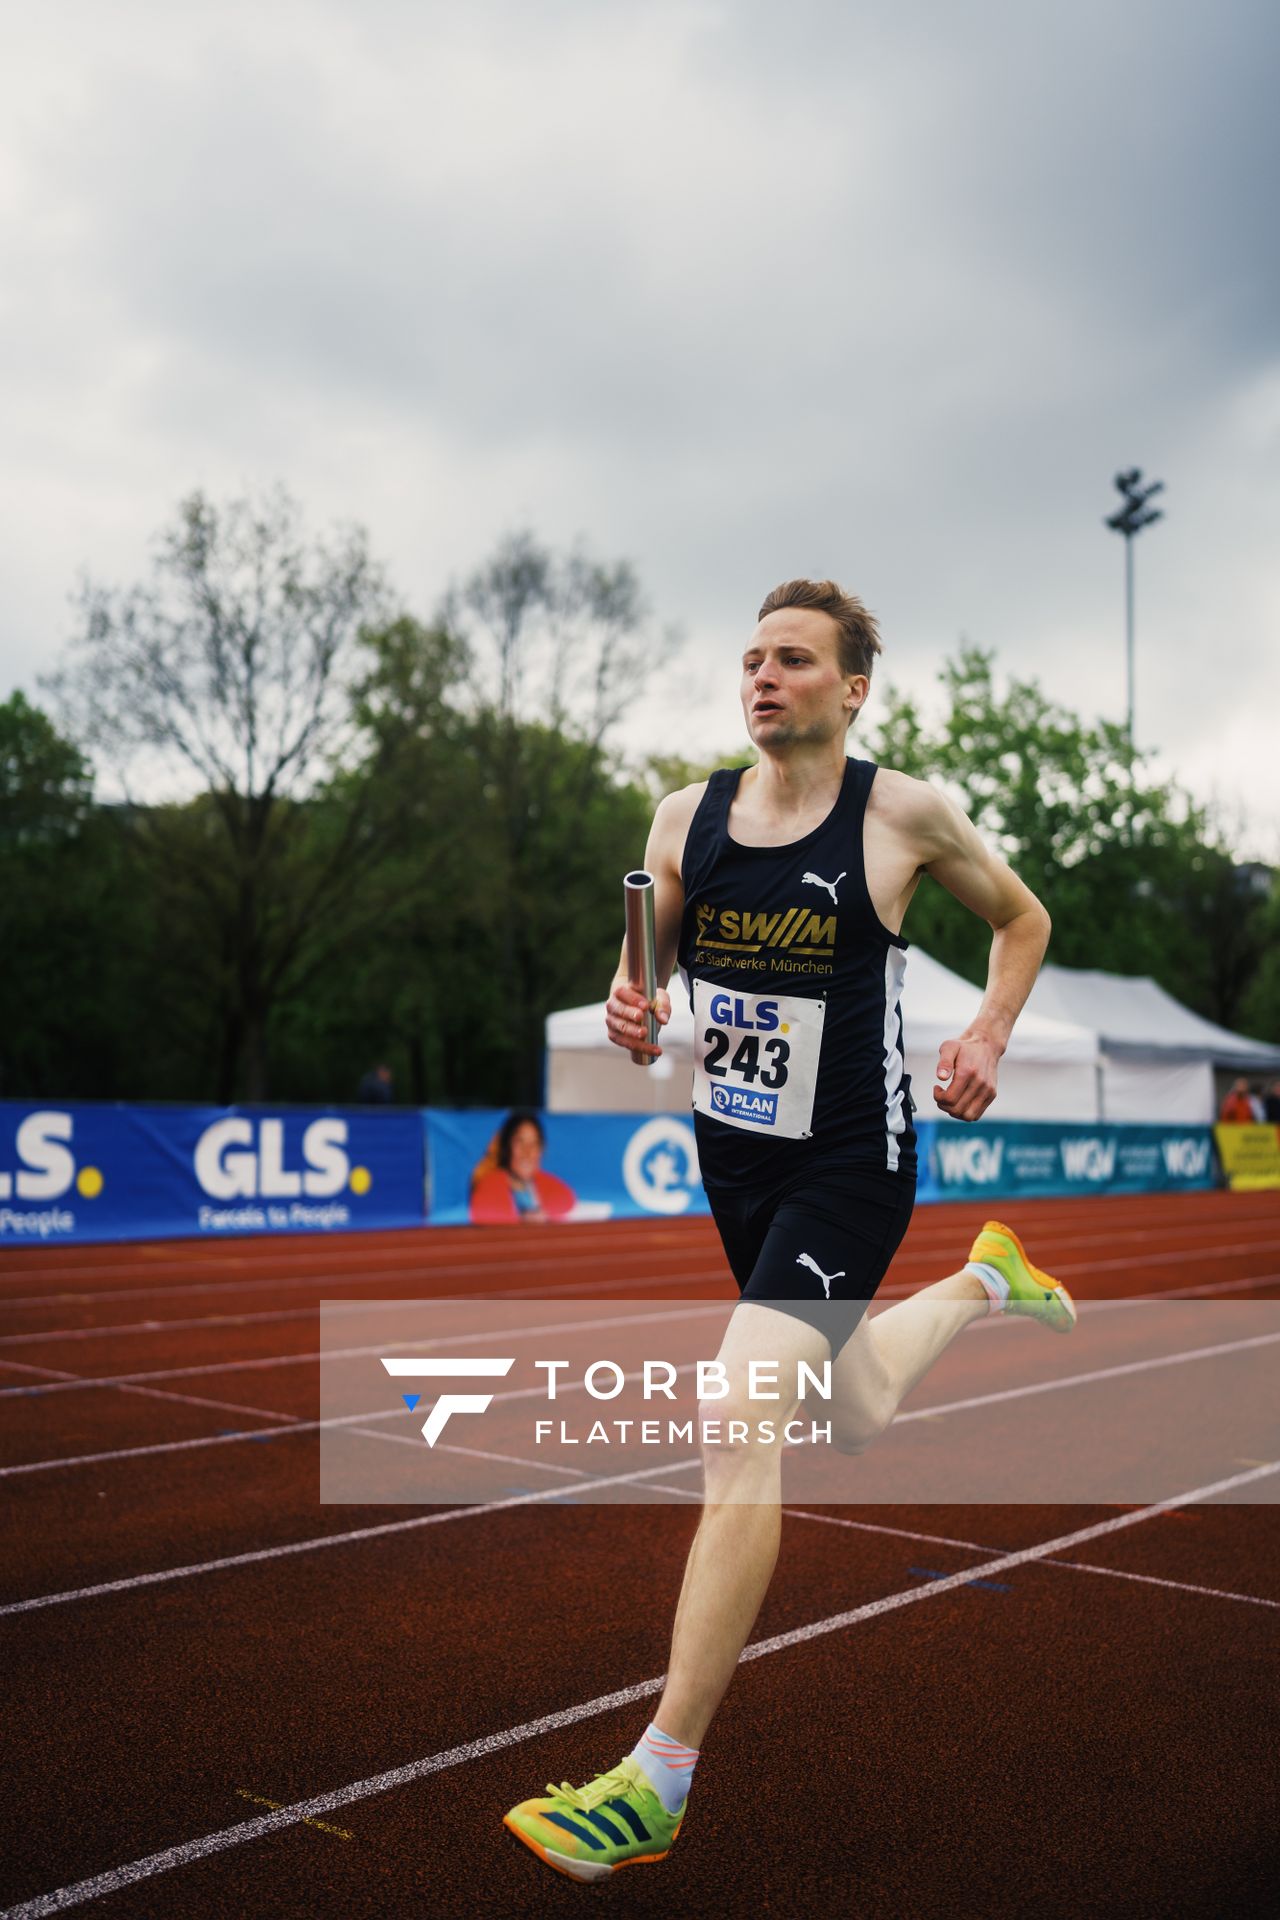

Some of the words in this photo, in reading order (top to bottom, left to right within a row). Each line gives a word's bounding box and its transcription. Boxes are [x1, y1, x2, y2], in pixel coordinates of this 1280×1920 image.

[707, 952, 767, 970] Stadtwerke
[771, 958, 833, 974] München
[703, 1027, 790, 1089] 243
[731, 1108, 771, 1121] INTERNATIONAL
[732, 1093, 774, 1114] PLAN
[0, 1206, 75, 1239] People
[290, 1202, 350, 1231] People
